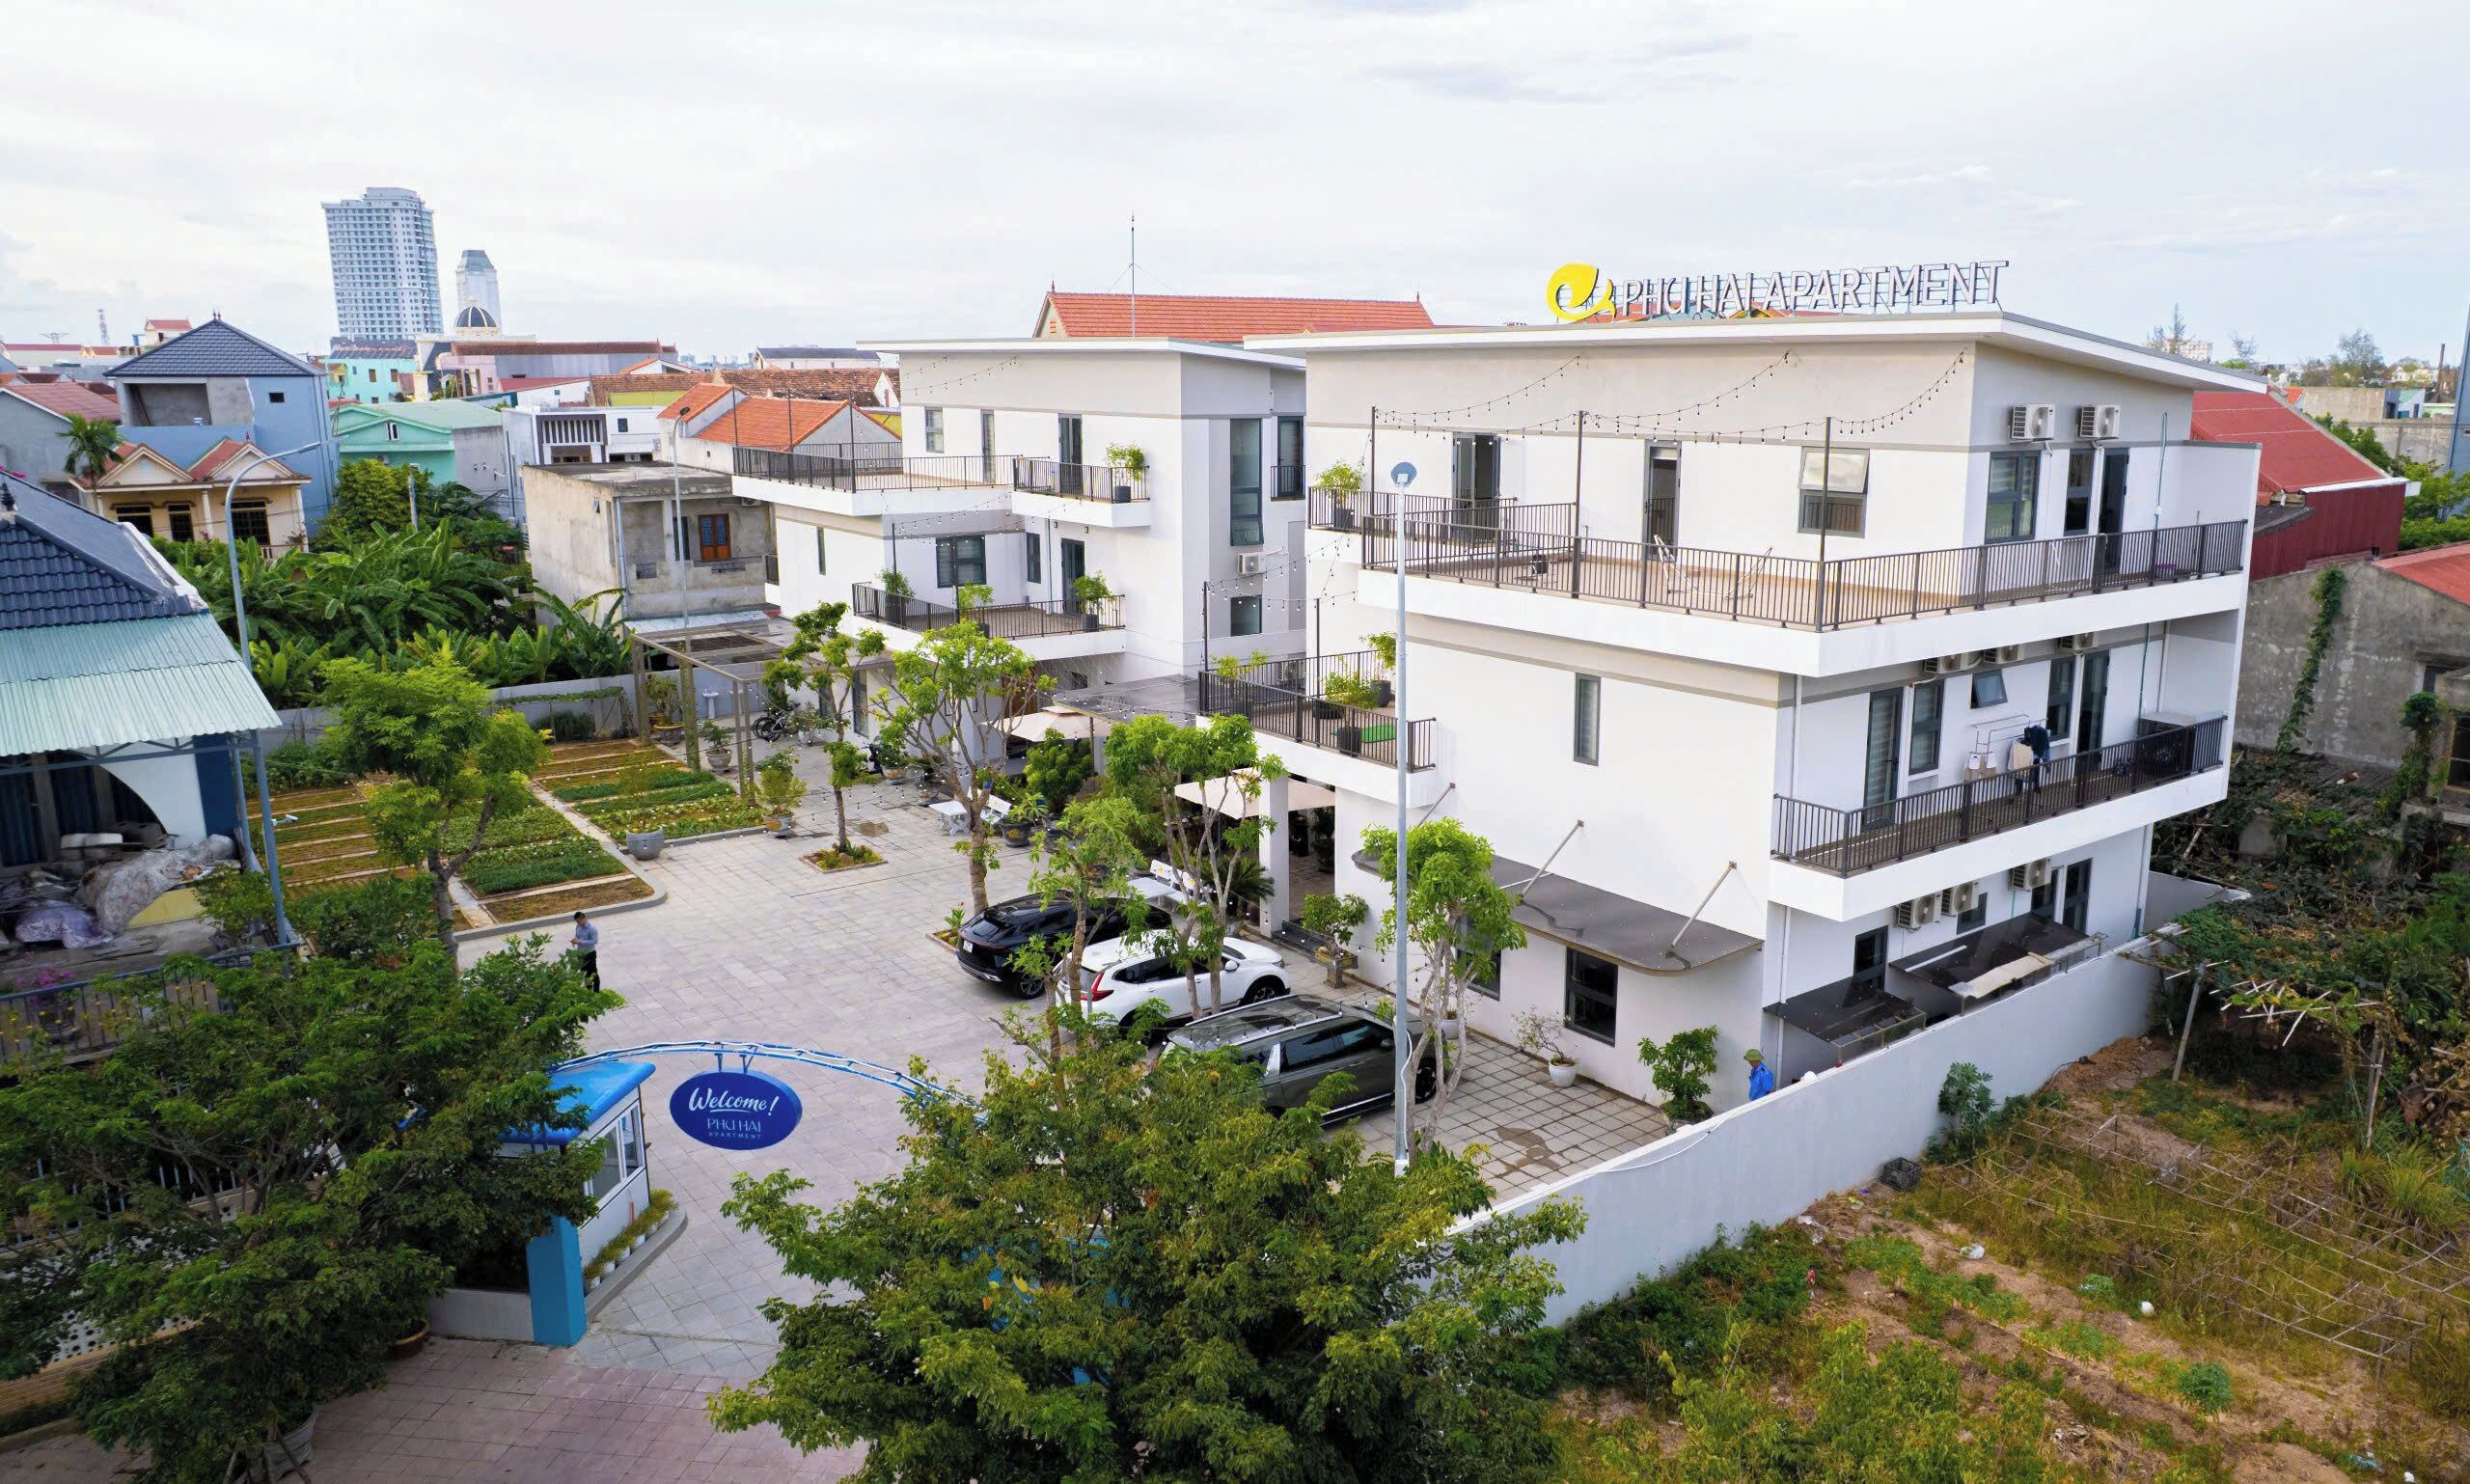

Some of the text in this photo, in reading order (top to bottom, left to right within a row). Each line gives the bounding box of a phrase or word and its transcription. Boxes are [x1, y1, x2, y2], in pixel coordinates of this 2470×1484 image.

[1696, 272, 1754, 316] HAI
[1762, 261, 2009, 311] APARTMENT
[738, 1119, 761, 1133] HAI
